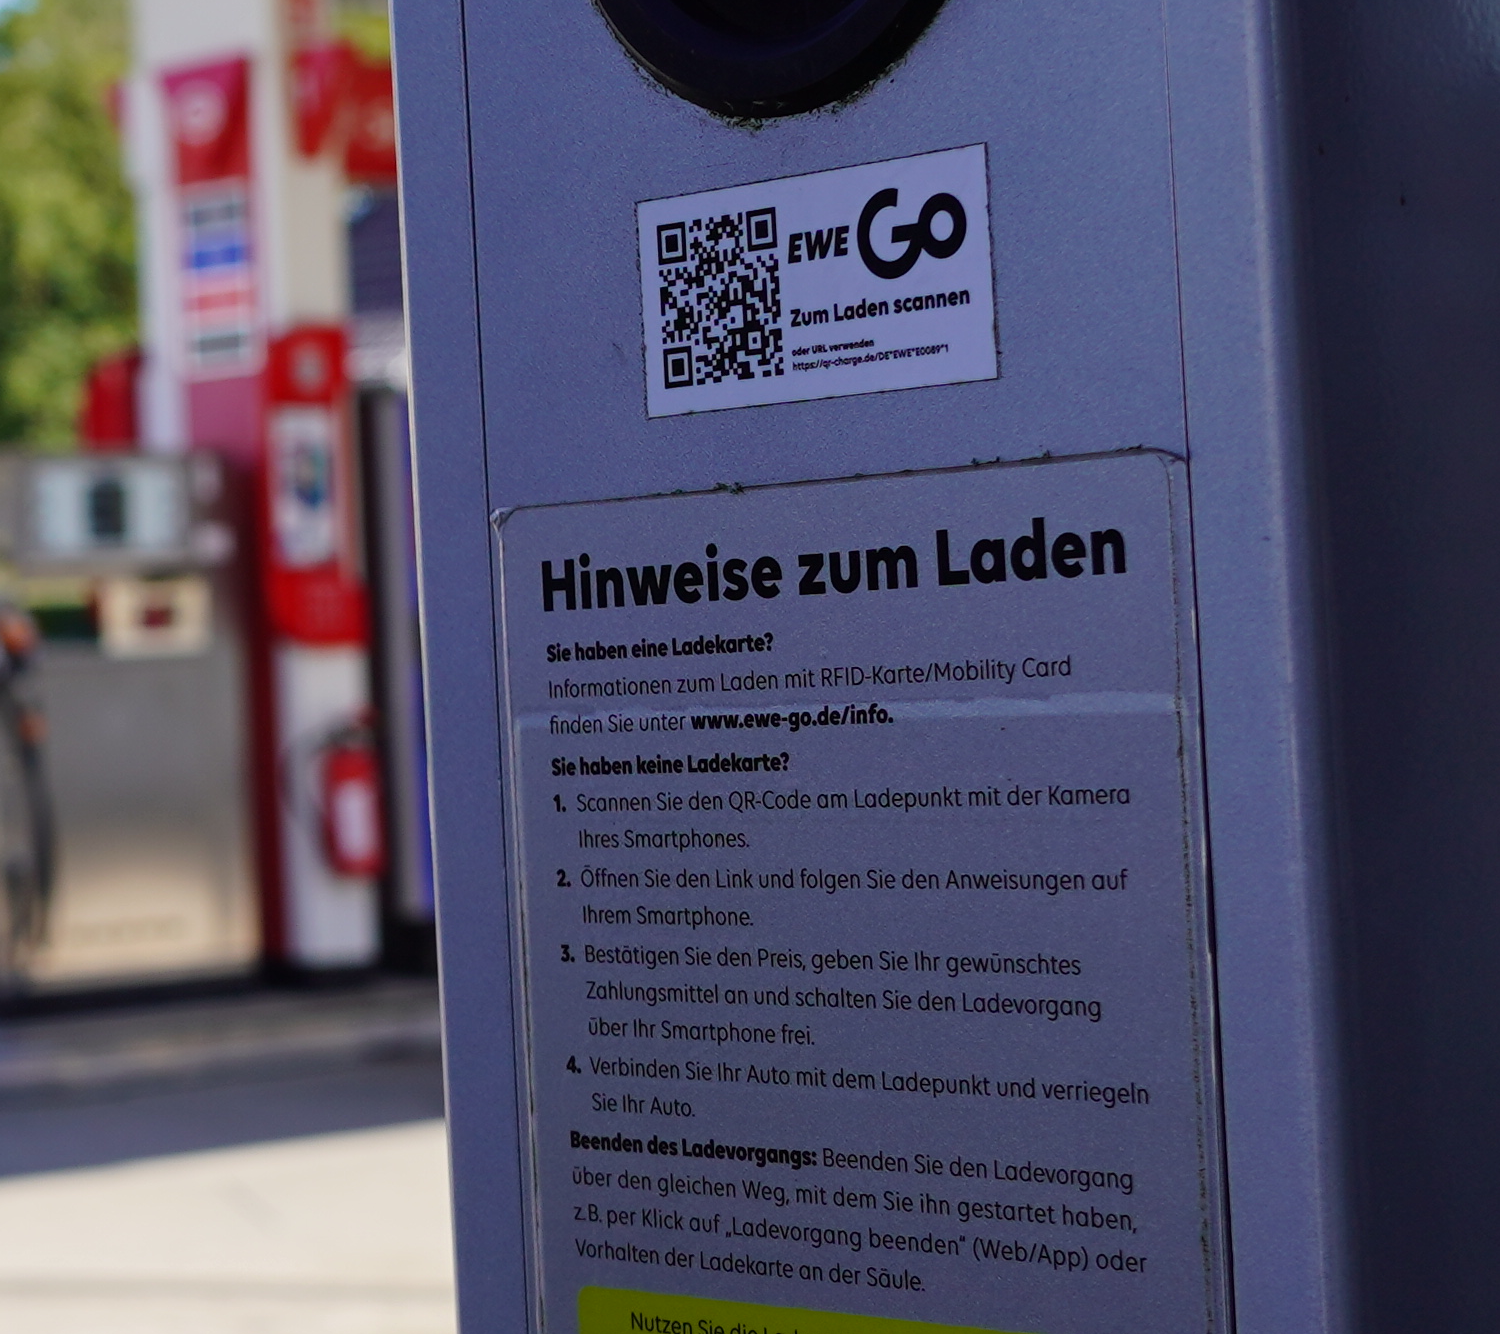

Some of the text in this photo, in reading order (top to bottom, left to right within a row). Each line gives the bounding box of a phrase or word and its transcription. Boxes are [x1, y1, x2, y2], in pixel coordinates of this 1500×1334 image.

[787, 225, 850, 265] EWE
[790, 290, 970, 327] Zum Laden scannen
[792, 339, 874, 356] oder URL verwenden
[542, 517, 1126, 612] Hinweise zum Laden
[547, 632, 773, 663] Sie haben eine Ladekarte?
[549, 655, 1071, 698] Informationen zum Laden mit RFID-Karte/Mobility Card
[550, 703, 894, 734] finden Sie unter www.ewe-go.de/info.
[552, 752, 789, 776] Sie haben keine Ladekarte?
[553, 785, 1130, 813] 1. Scannen Sie den QR-Code am Ladepunkt mit der Kamera
[579, 828, 750, 853] Ihres Smartphones.
[561, 945, 1081, 977] 3. Bestätigen Sie den Preis, geben Sie Ihr gewünschtes
[566, 1055, 1149, 1107] 4. Verbinden Sie Ihr Auto mit dem Ladepunkt und verriegeln
[592, 1093, 695, 1117] Sie Ihr Auto.
[570, 1131, 1133, 1195] Beenden des Ladevorgangs: Beenden Sie den Ladevorgang
[574, 1204, 1147, 1273] z.B. per Klick auf „Ladevorgang beenden“ (Web/App) oder
[575, 1239, 925, 1291] Vorhalten der Ladekarte an der Säule.
